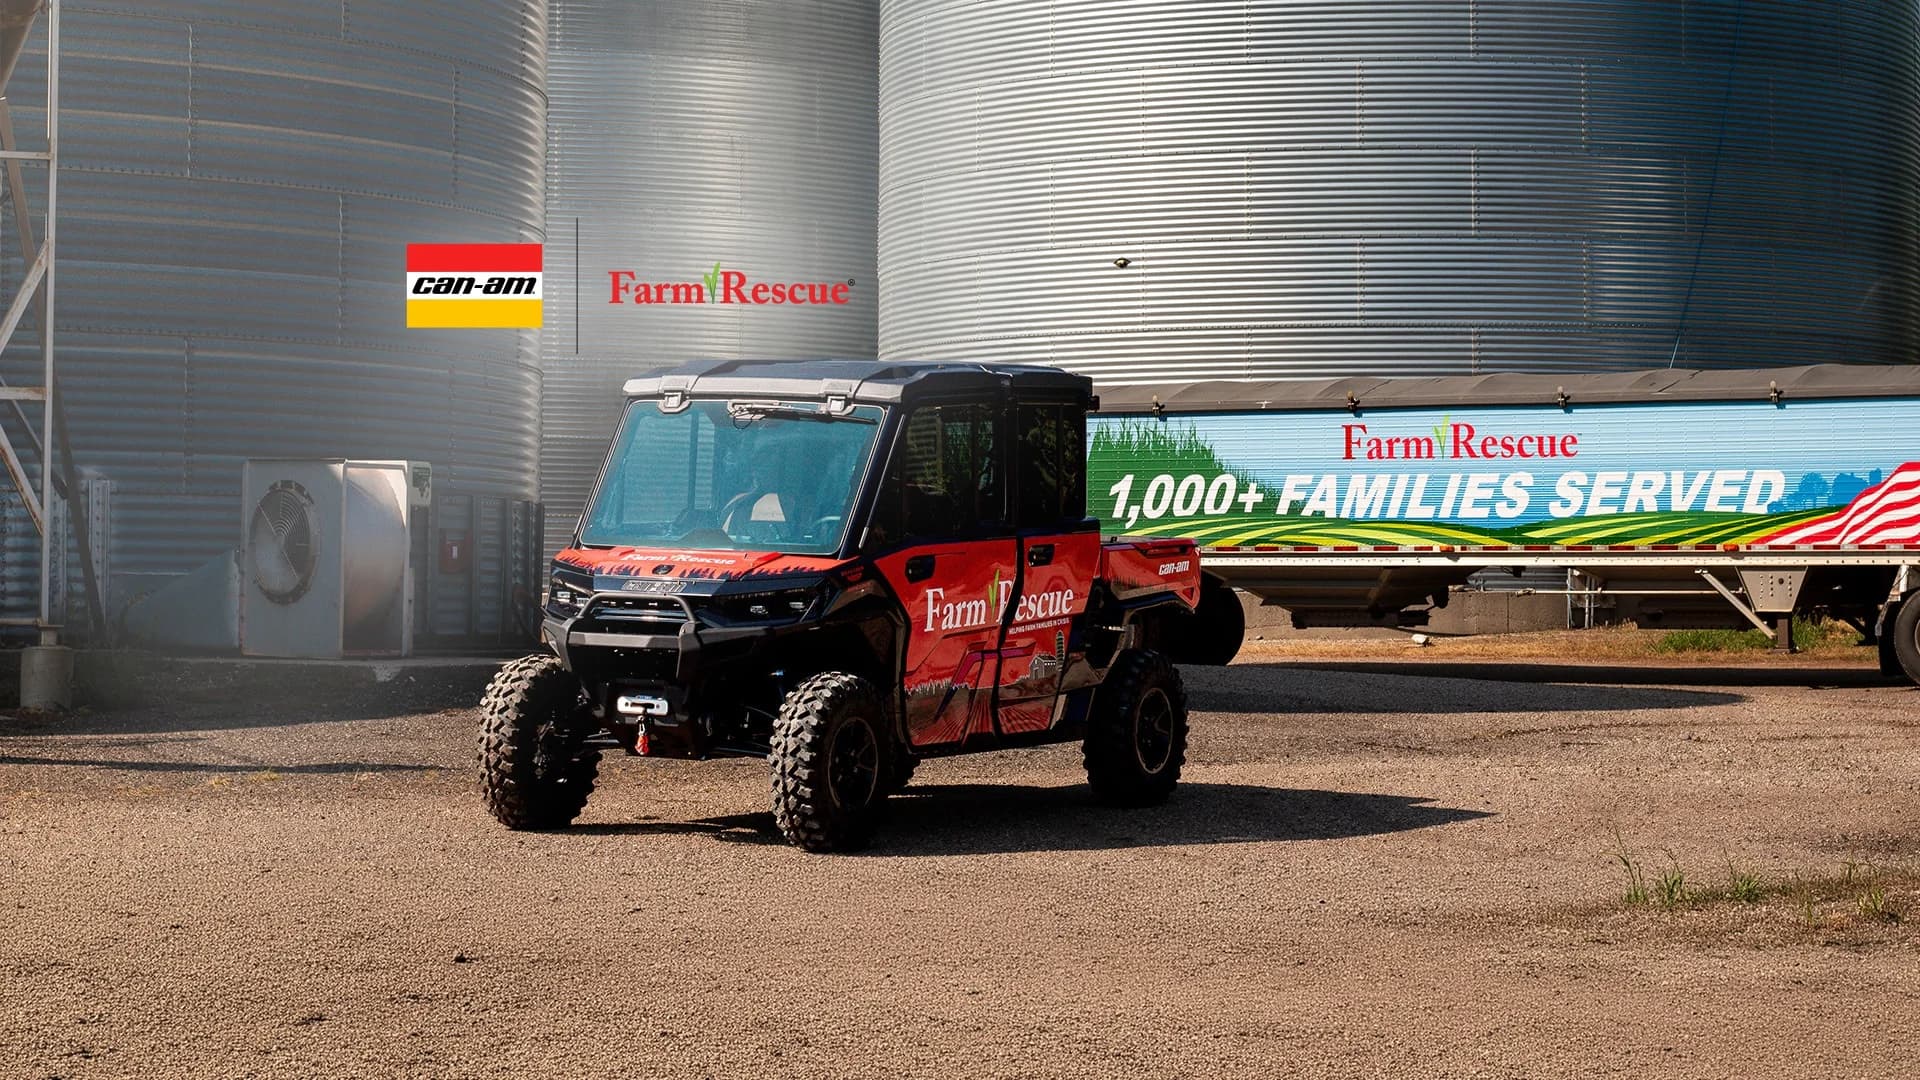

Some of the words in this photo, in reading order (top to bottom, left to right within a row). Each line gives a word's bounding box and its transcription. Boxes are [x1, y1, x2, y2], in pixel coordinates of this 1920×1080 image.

[1341, 424, 1435, 460] Farm
[1109, 473, 1264, 529] 1,000+
[1275, 471, 1534, 519] FAMILIES
[1549, 470, 1786, 518] SERVED
[1159, 560, 1190, 576] can-am
[924, 587, 986, 632] Farm
